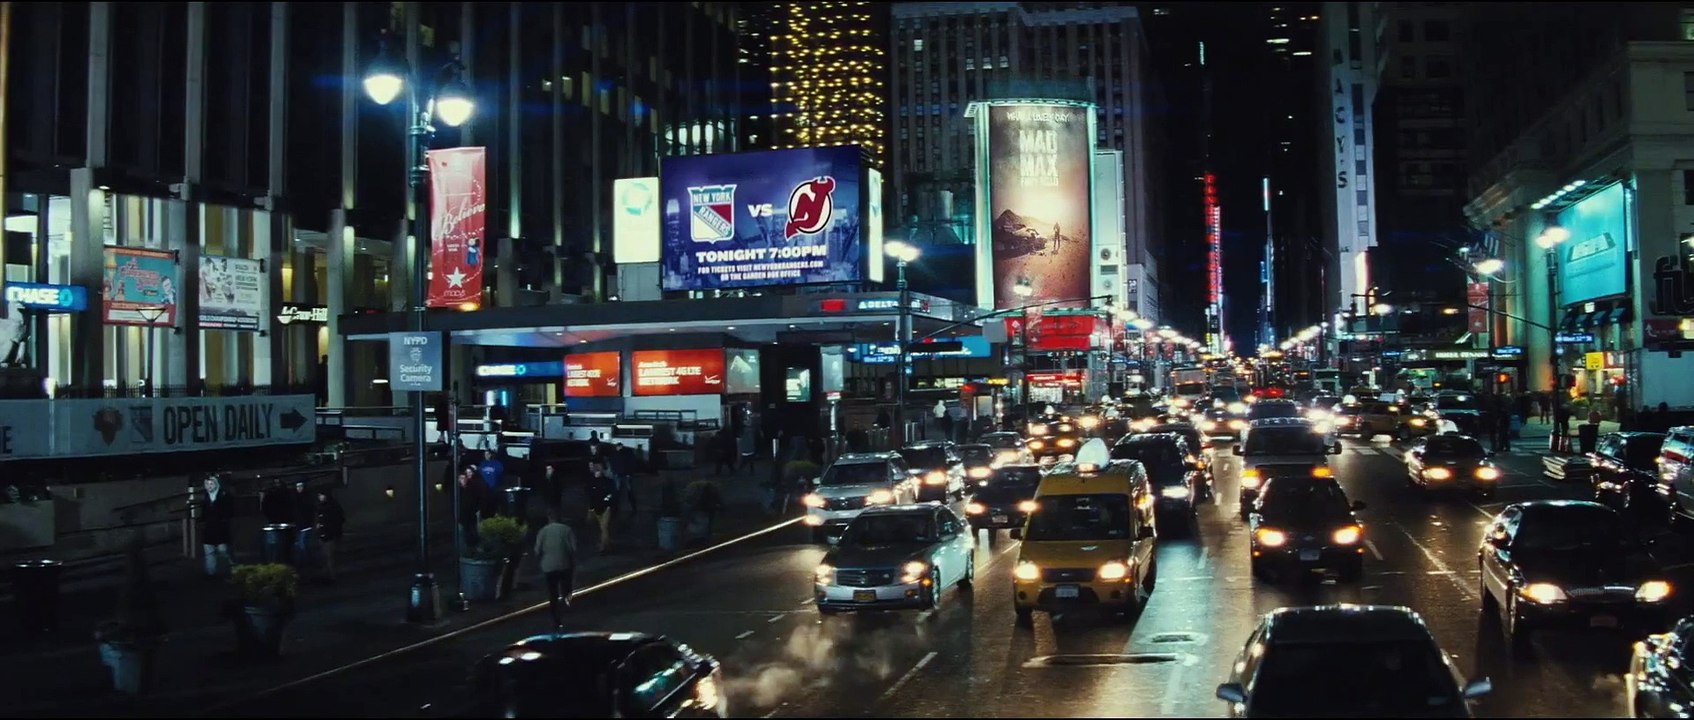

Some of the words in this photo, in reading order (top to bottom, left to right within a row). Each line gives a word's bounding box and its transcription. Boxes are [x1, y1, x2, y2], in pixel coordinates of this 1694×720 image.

[1019, 130, 1058, 153] MAD
[1020, 153, 1058, 176] MAX
[693, 194, 710, 203] NEW
[711, 192, 731, 202] YORK
[698, 206, 731, 237] RANGERS
[696, 248, 767, 263] TONIGHT
[769, 245, 827, 259] 7:00PM
[5, 286, 60, 305] CHASE
[866, 300, 899, 308] DELTA
[403, 336, 428, 345] NYPD
[400, 364, 432, 374] Security
[400, 374, 431, 382] Camera
[164, 405, 218, 445] OPEN
[225, 404, 273, 441] DAILY
